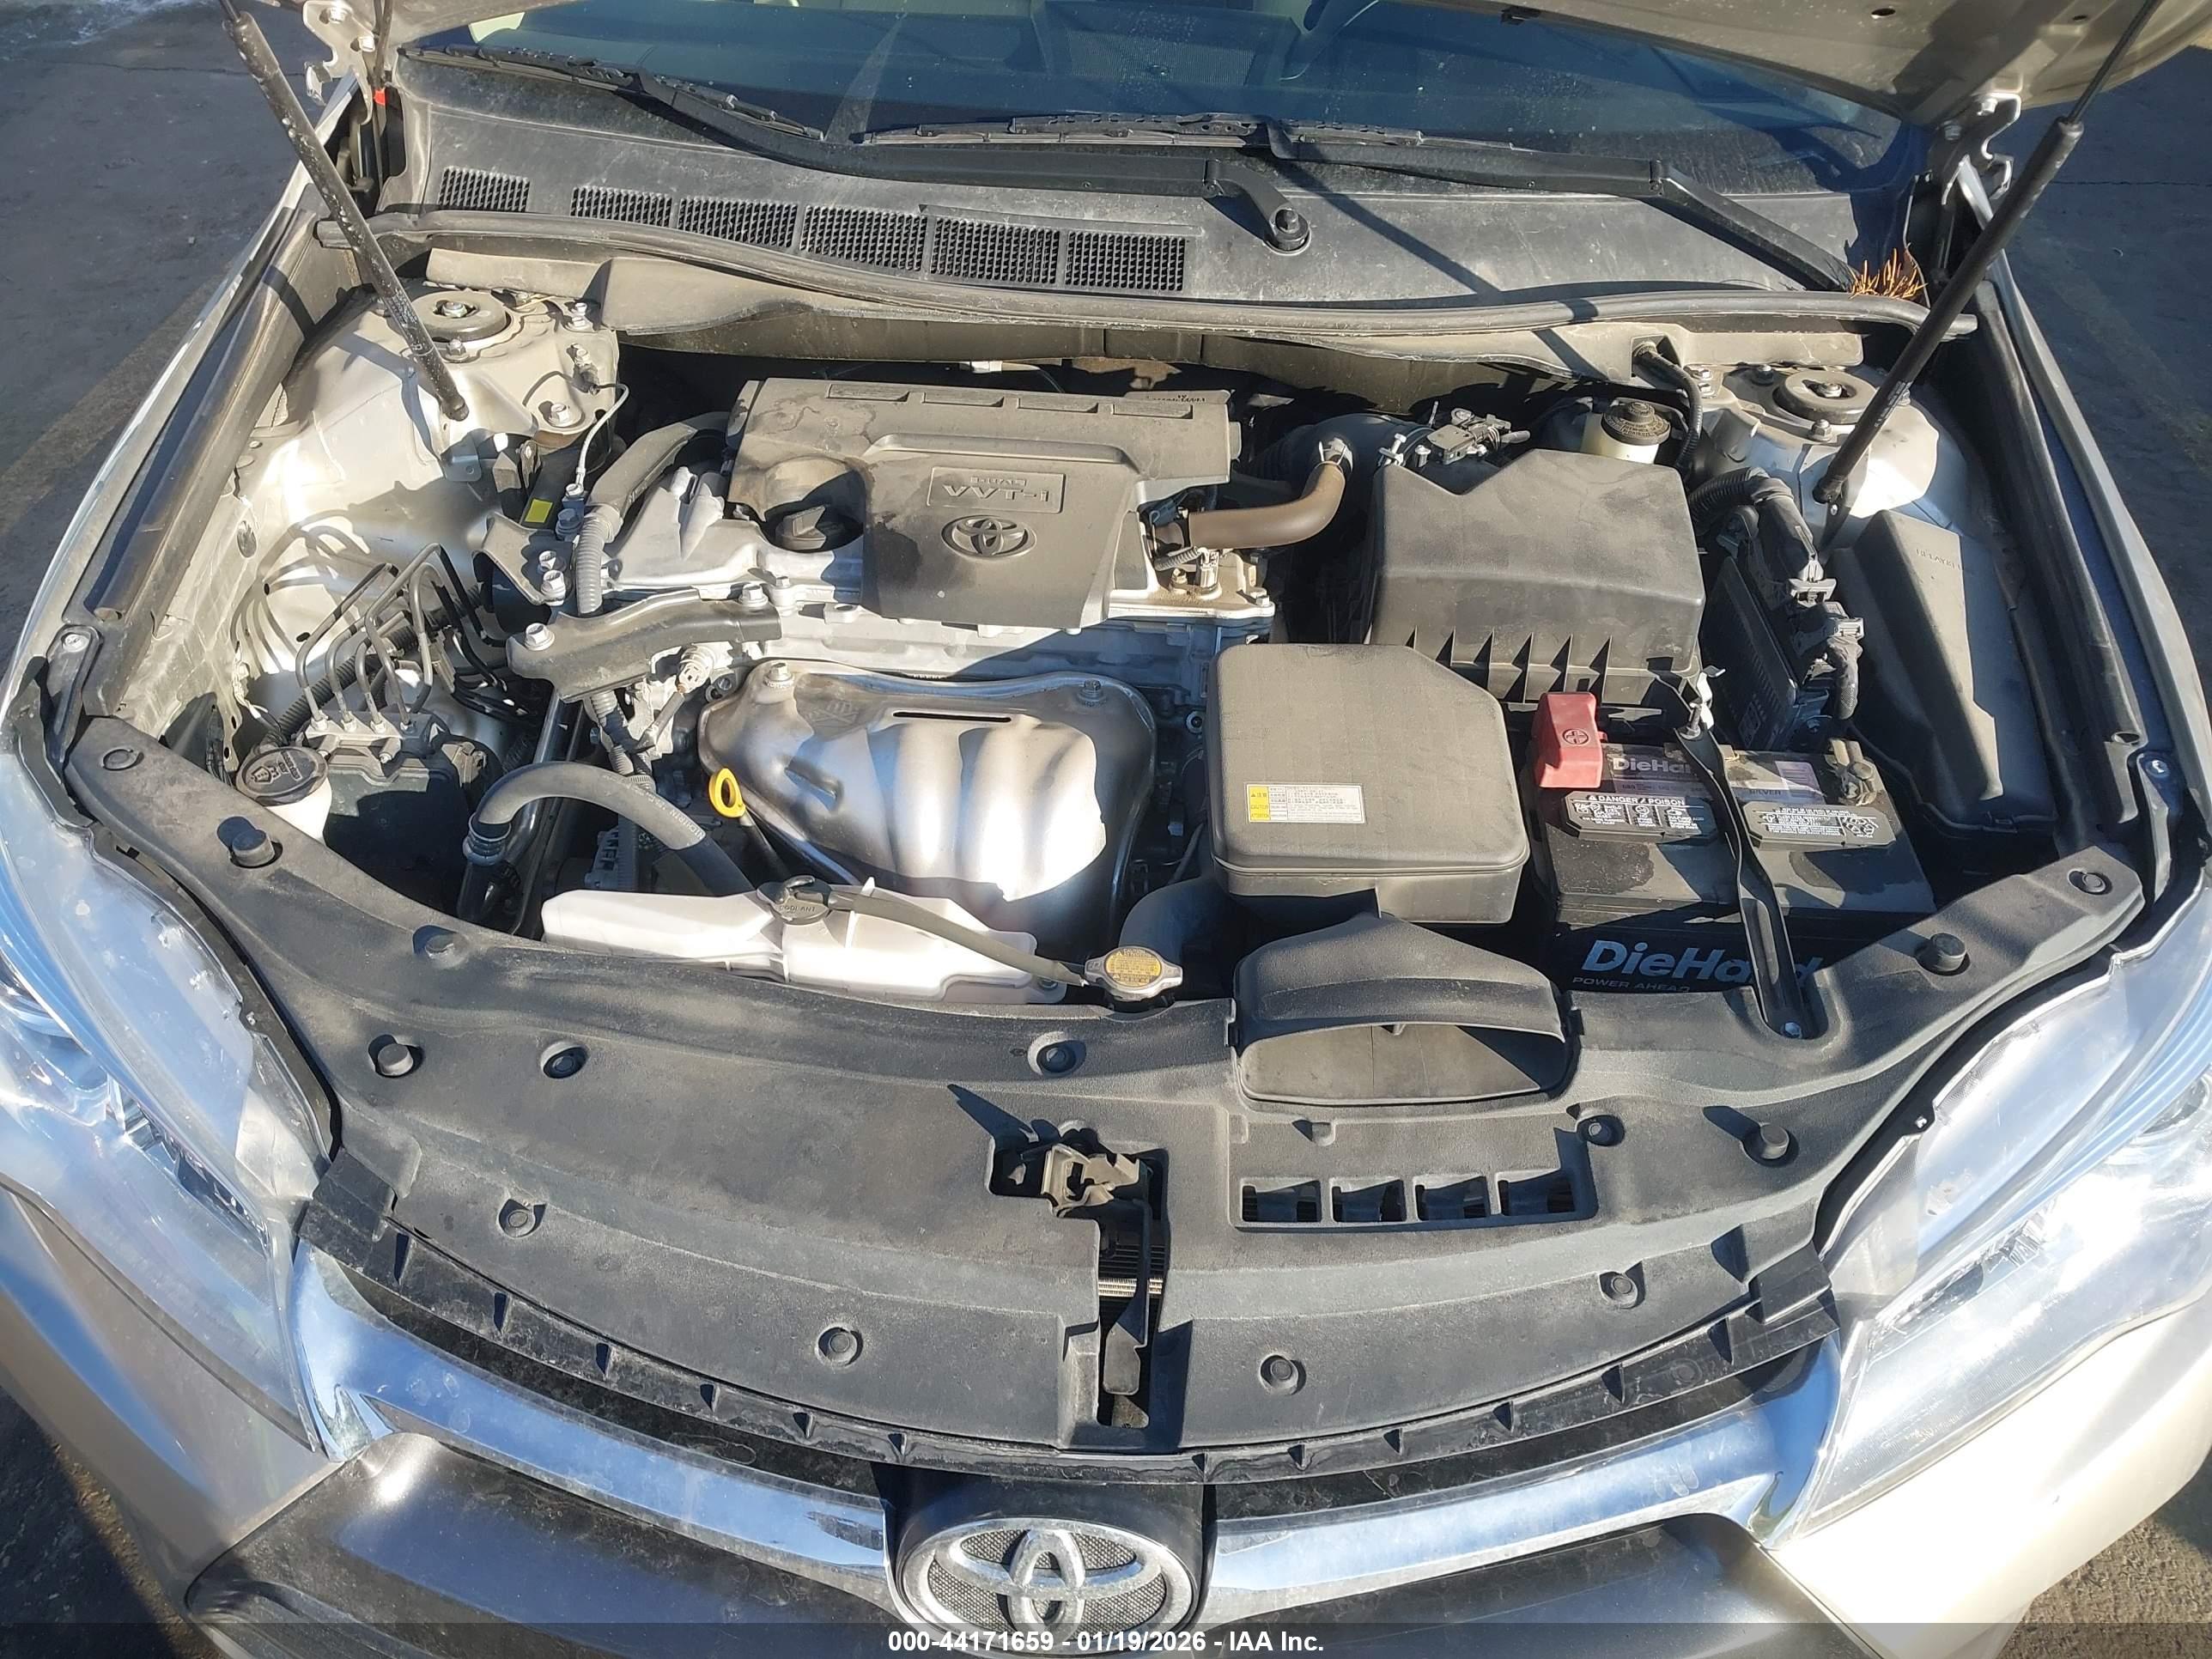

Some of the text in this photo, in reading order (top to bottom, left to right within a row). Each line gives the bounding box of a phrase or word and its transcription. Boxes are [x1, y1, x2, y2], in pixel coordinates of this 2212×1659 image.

[943, 483, 1049, 501] VVT-i
[1598, 795, 1638, 804] DANGER
[1572, 976, 1630, 988] POWER
